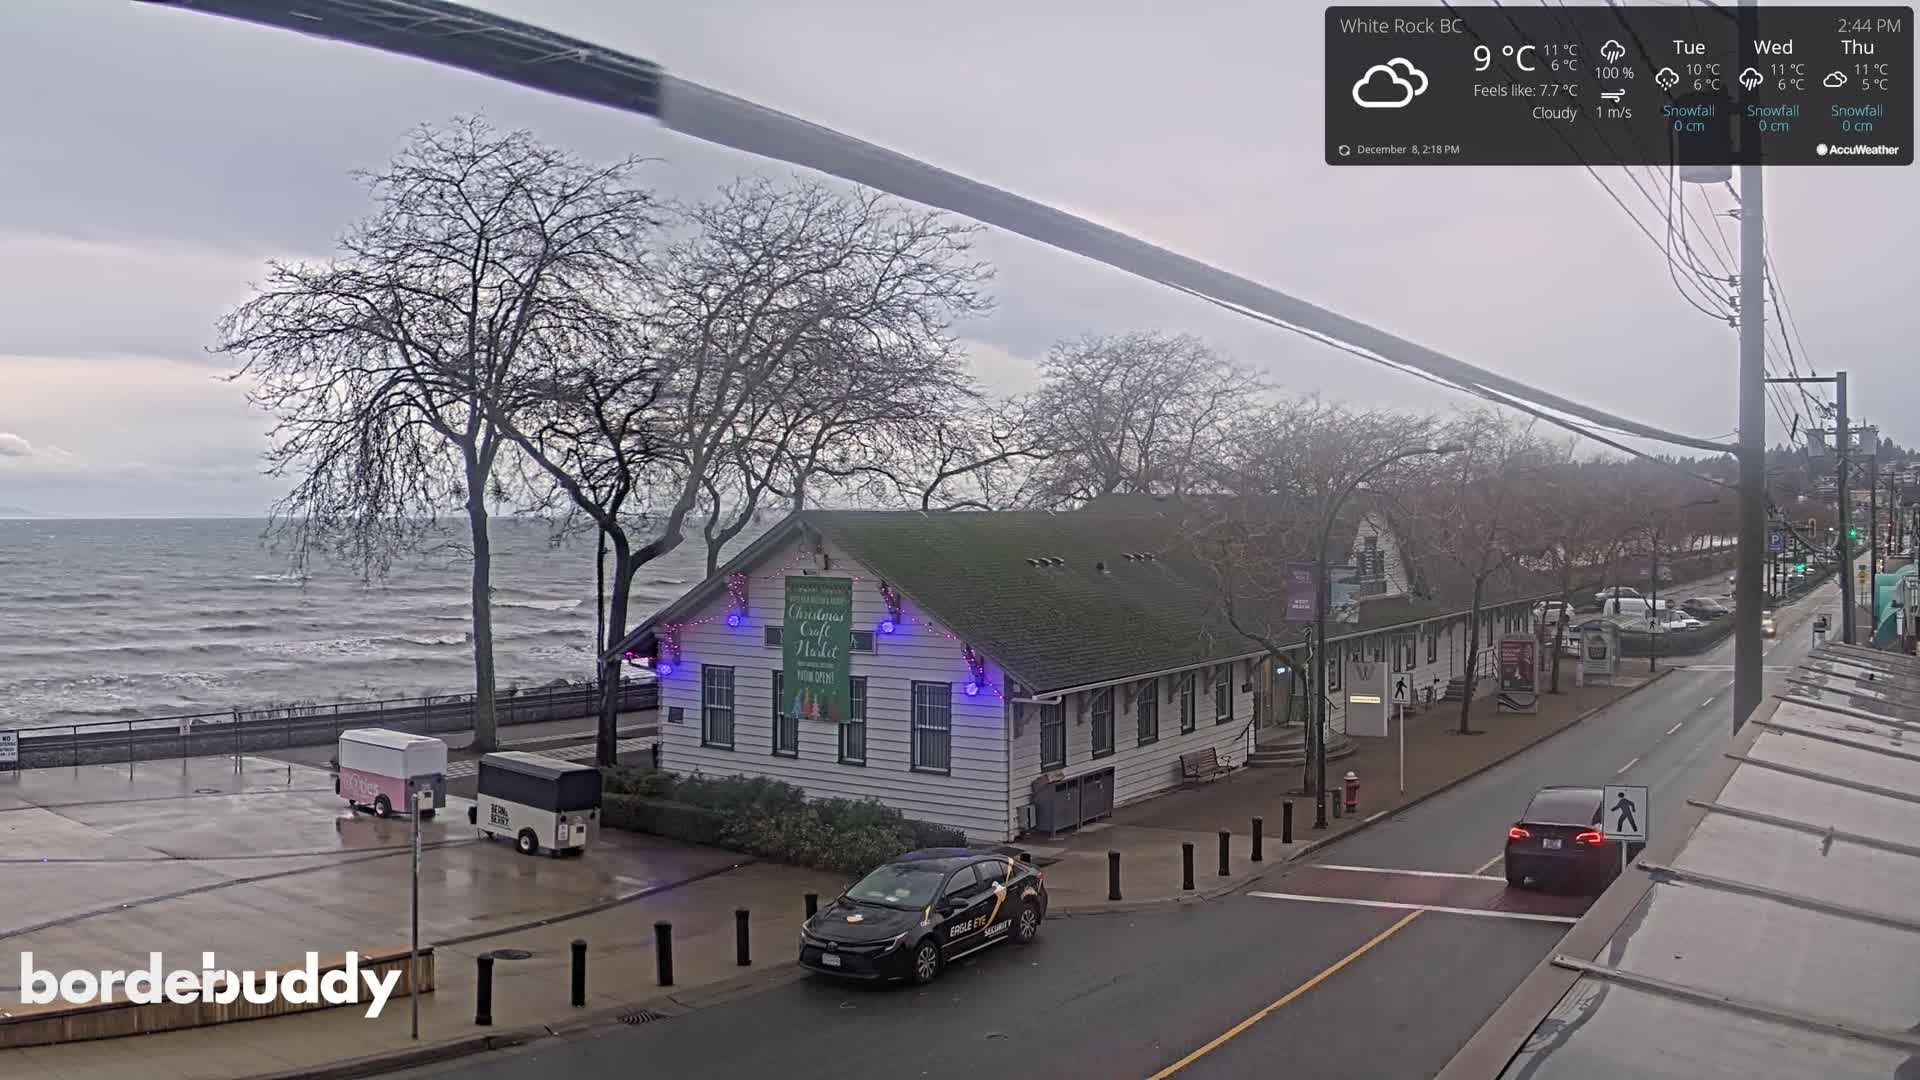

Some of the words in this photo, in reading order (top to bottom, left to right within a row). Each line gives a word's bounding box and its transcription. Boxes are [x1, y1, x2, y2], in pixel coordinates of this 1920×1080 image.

[788, 604, 844, 622] Christmas
[800, 621, 830, 645] Craft
[795, 640, 838, 659] Market
[950, 920, 972, 937] EAGLE
[974, 915, 987, 928] EYE
[984, 919, 1012, 937] SECURITY
